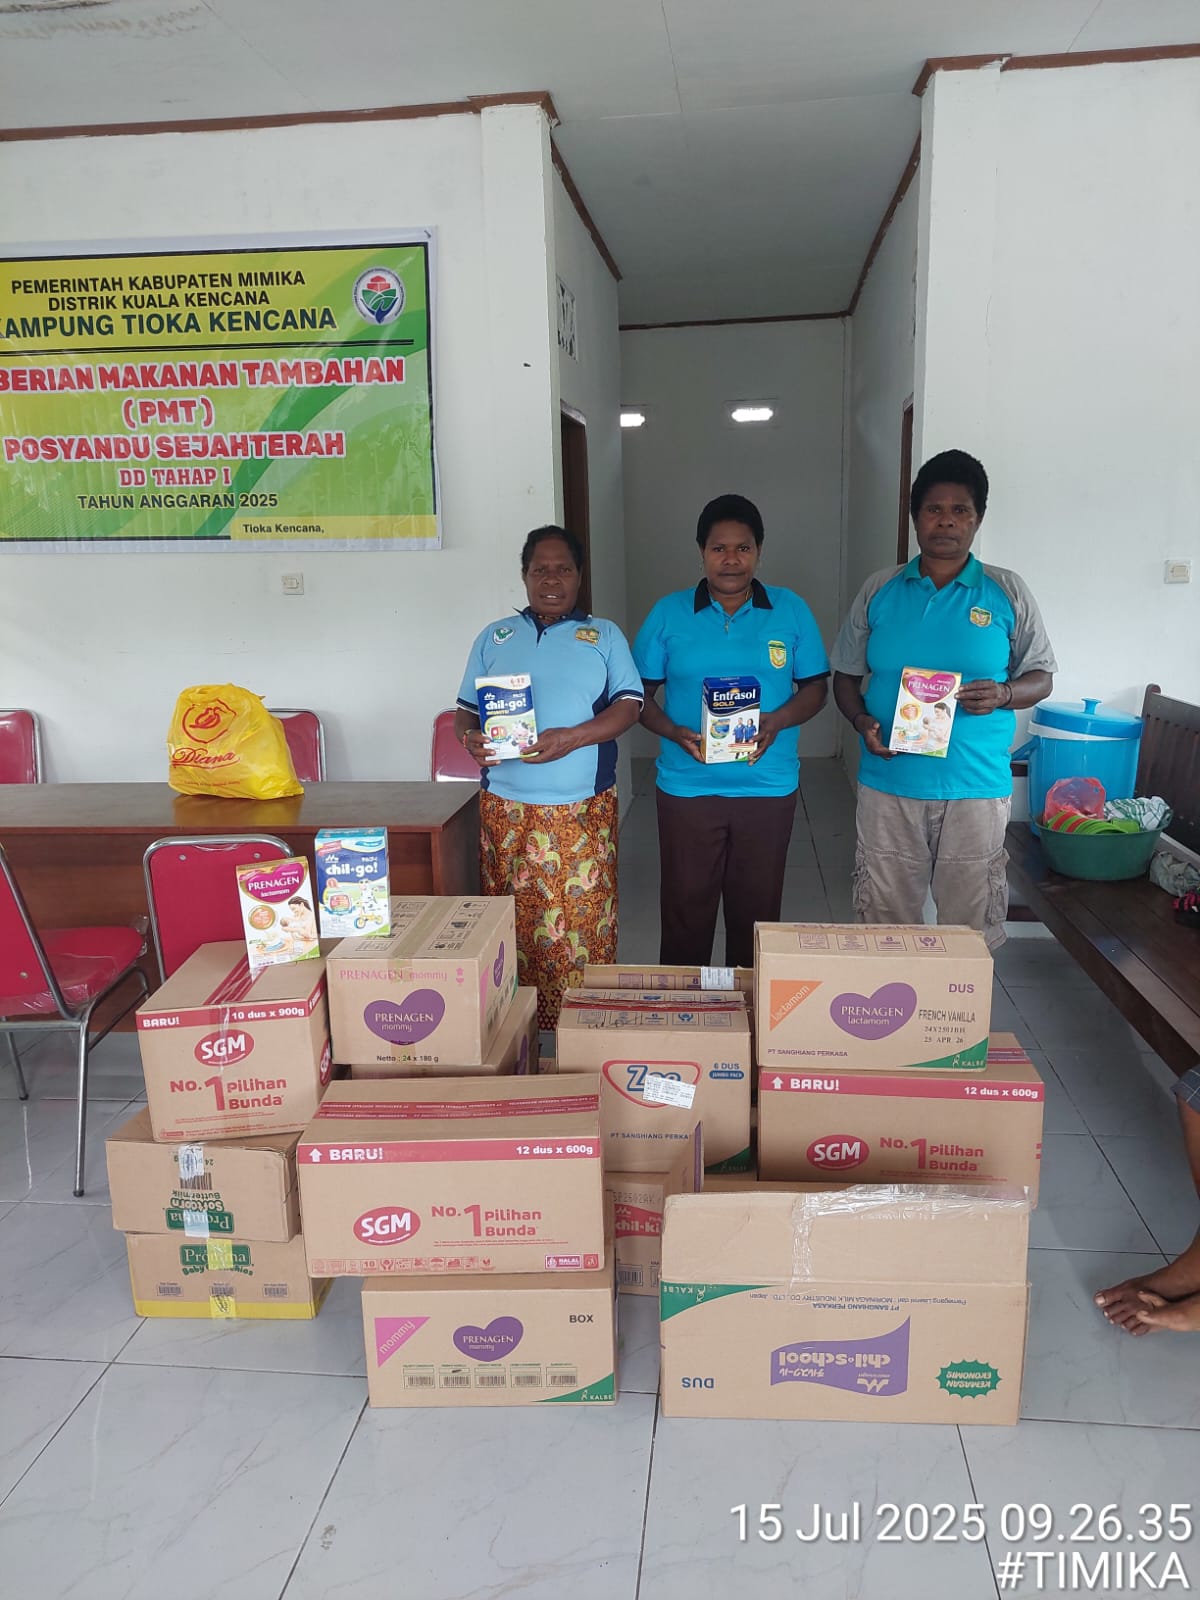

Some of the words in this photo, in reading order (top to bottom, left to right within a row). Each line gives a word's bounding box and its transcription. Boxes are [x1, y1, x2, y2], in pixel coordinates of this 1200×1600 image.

[12, 277, 123, 294] PEMERINTAH
[129, 273, 232, 290] KABUPATEN
[238, 271, 305, 287] MIMIKA
[48, 295, 117, 311] DISTRIK
[122, 294, 180, 309] KUALA
[185, 291, 270, 307] KENCANA
[121, 313, 201, 334] TIOKA
[209, 308, 337, 332] KENCANA
[98, 363, 238, 389] MAKANAN
[243, 359, 404, 386] TAMBAHAN
[123, 397, 214, 428] (PMT)
[4, 435, 150, 461] POSYANDU
[156, 432, 345, 459] SEJAHTERAH
[119, 469, 146, 486] DD
[153, 468, 217, 485] TAHAP
[223, 467, 231, 484] I
[78, 495, 134, 509] TAHUN
[140, 494, 234, 508] ANGGARAN
[239, 493, 278, 507] 2025
[243, 523, 272, 533] Tioka
[275, 523, 325, 534] Kencana,
[908, 680, 950, 693] PRENAGEN
[713, 688, 756, 702] Entrasol
[172, 748, 237, 765] Diana
[248, 876, 300, 891] PRENAGEN
[340, 969, 403, 980] PRENAGEN
[409, 970, 448, 982] mommy
[949, 983, 974, 994] DUS
[771, 984, 810, 1022] lactamom
[232, 1012, 244, 1020] 10
[247, 1009, 266, 1018] dus
[279, 1007, 304, 1017] 900g
[375, 1012, 434, 1022] PRENAGEN
[841, 1005, 904, 1017] PRENAGEN
[919, 1009, 946, 1021] FRENCH
[948, 1010, 976, 1022] VANILLA
[143, 1017, 180, 1028] BARU!
[848, 1016, 890, 1025] lactamom
[382, 1024, 412, 1033] mommy
[201, 1034, 246, 1060] SGM
[722, 1062, 740, 1070] DUS
[790, 1077, 840, 1091] BARU!
[170, 1080, 202, 1093] No.
[204, 1075, 226, 1111] 1
[227, 1078, 287, 1094] Pilihan
[964, 1087, 977, 1095] 12
[980, 1086, 999, 1096] dus
[1012, 1088, 1038, 1099] 600g
[229, 1094, 283, 1110] Bunda
[329, 1147, 383, 1160] BARU!
[516, 1146, 529, 1155] 12
[533, 1145, 553, 1154] dus
[555, 1146, 562, 1154] x
[566, 1143, 593, 1155] 600g
[814, 1141, 860, 1162] SGM
[880, 1137, 907, 1149] No.
[910, 1138, 927, 1169] 1
[929, 1145, 984, 1157] Pilihan
[929, 1160, 978, 1172] Bunda
[171, 1198, 224, 1212] Softcorn
[361, 1212, 411, 1237] SGM
[431, 1206, 461, 1217] No.
[464, 1204, 482, 1236] 1
[484, 1208, 541, 1221] Pilihan
[485, 1224, 536, 1236] Bunda
[182, 1264, 204, 1276] Baby
[663, 1285, 693, 1293] KALBE
[802, 1295, 837, 1303] INDUSTRY
[855, 1296, 893, 1304] MORINAGA
[569, 1314, 594, 1323] BOX
[379, 1319, 416, 1355] mommy
[463, 1334, 514, 1344] PRENAGEN
[682, 1377, 714, 1388] DUS
[945, 1379, 991, 1388] KEMASAN
